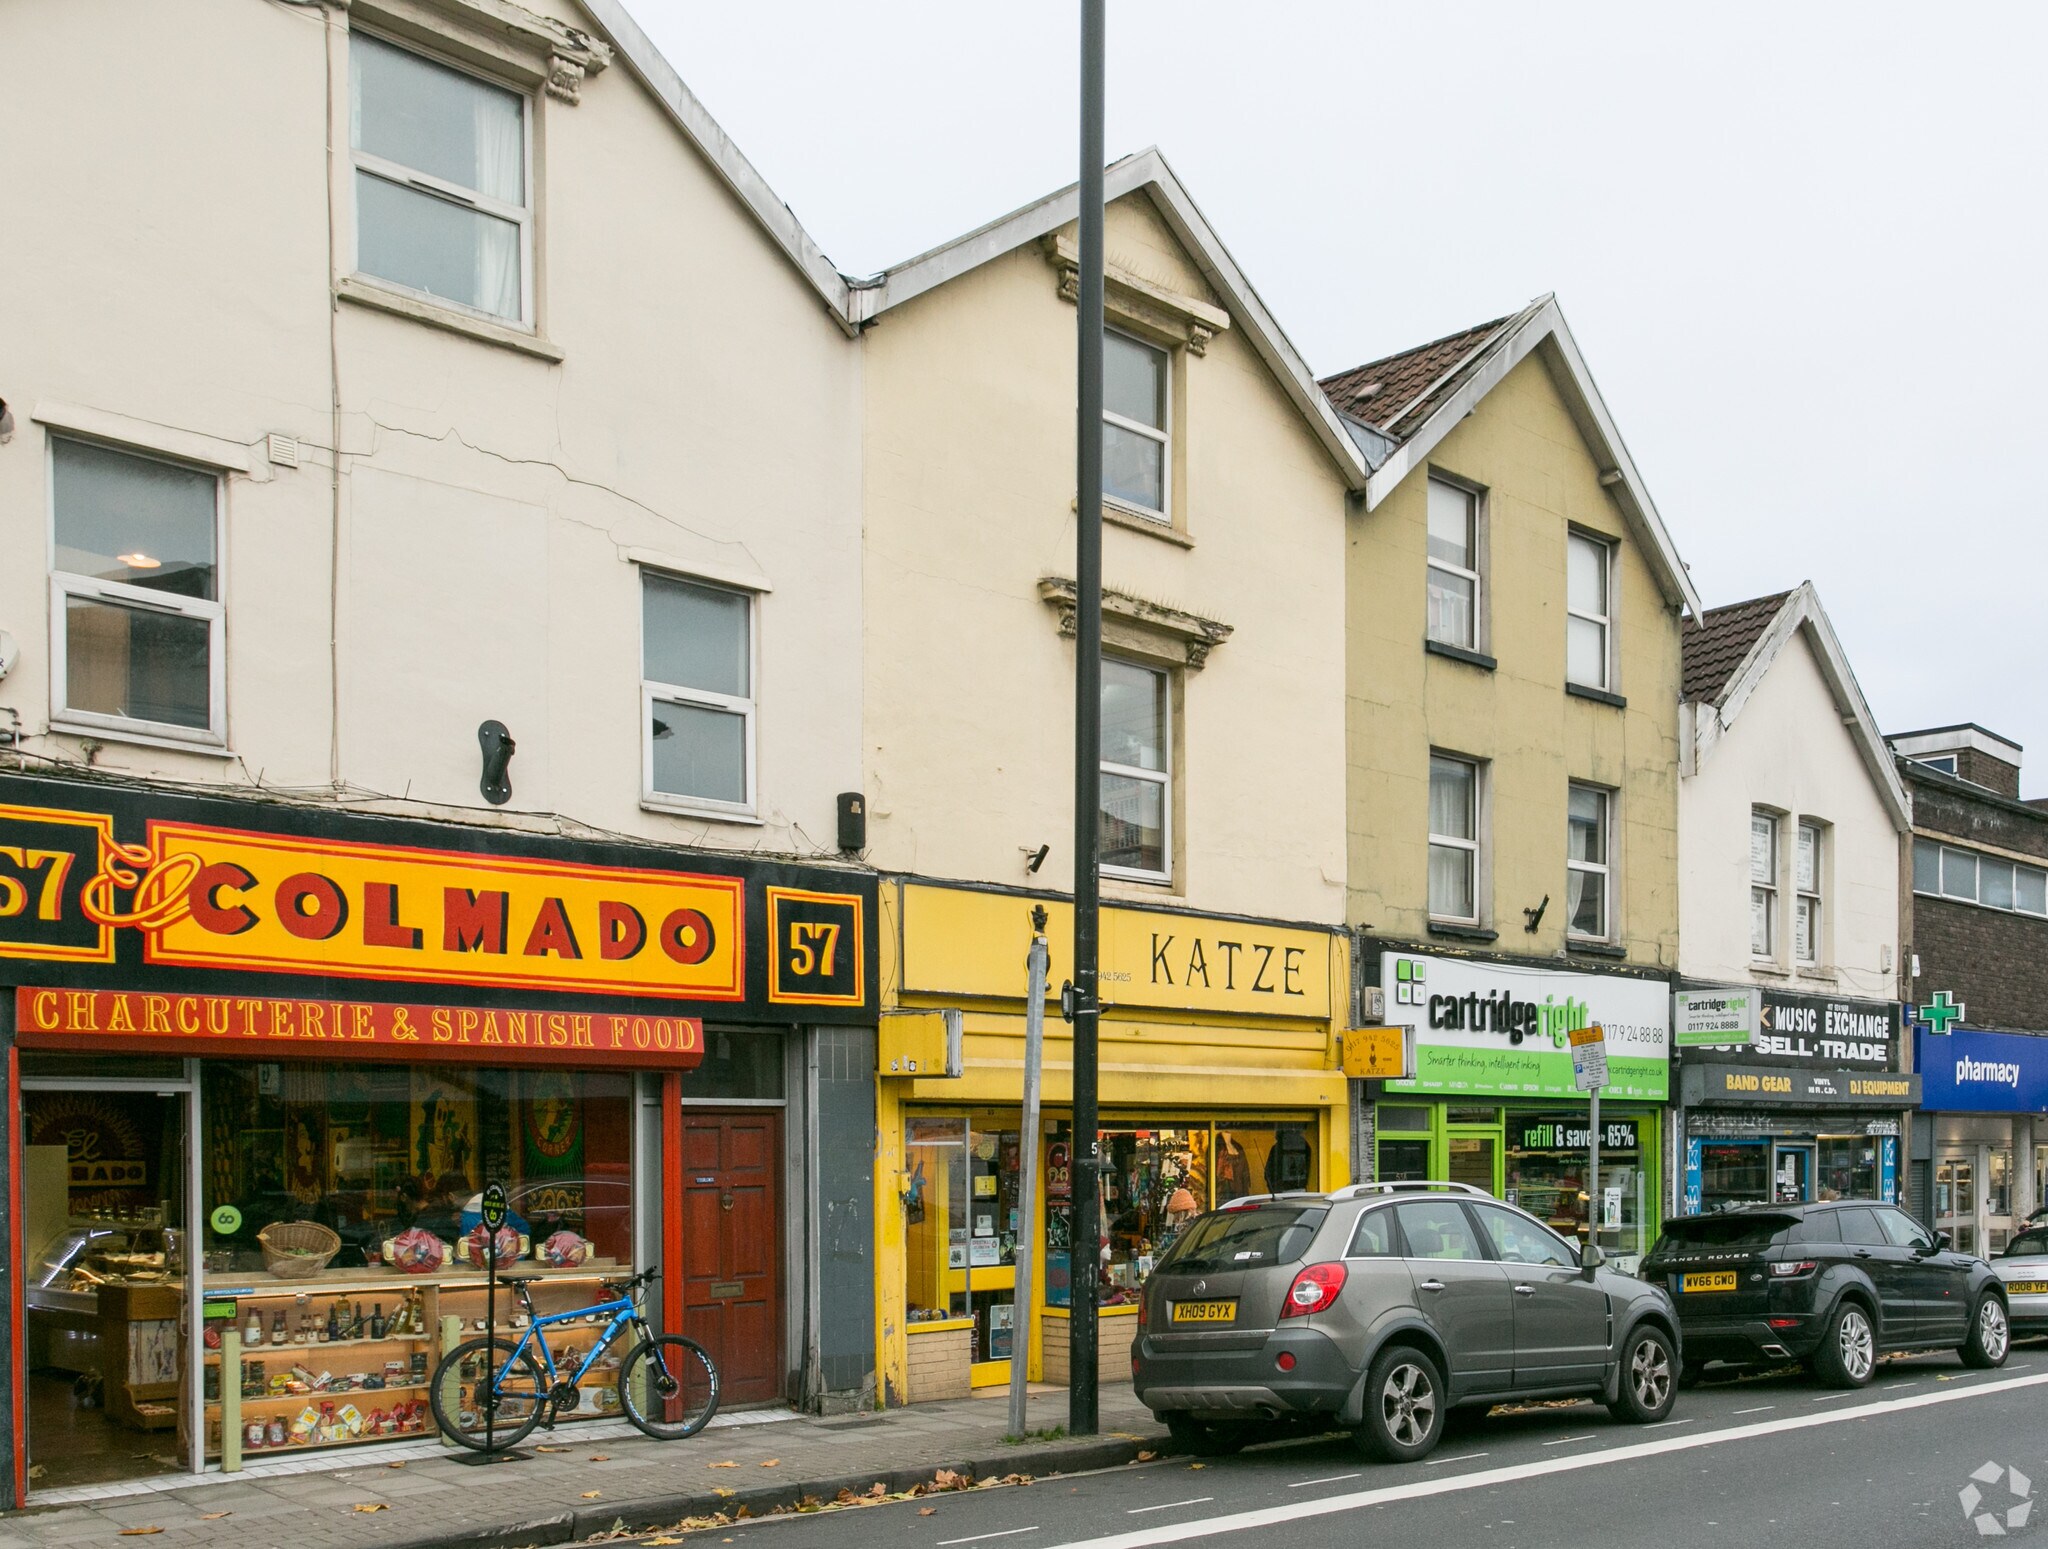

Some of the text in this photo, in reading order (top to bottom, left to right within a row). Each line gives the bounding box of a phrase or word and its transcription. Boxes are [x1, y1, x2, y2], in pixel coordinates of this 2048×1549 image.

[81, 830, 716, 965] El COLMADO
[790, 922, 840, 976] 57
[1151, 933, 1306, 996] KATZE
[1113, 972, 1131, 982] 5625
[1688, 997, 1746, 1012] cartridgeright
[33, 991, 695, 1050] CHARCUTERIE & SPANISH FOOD
[1429, 988, 1590, 1048] cartridgeright
[1688, 1021, 1739, 1031] 0117 924 8888
[1775, 1005, 1817, 1033] MUSIC
[1825, 1010, 1890, 1039] EXCHANGE
[1603, 1024, 1617, 1041] 117
[1755, 1034, 1887, 1062] SELL TRADE
[1360, 1067, 1386, 1075] KATZE
[1427, 1050, 1455, 1066] Smarter
[1488, 1054, 1520, 1075] intelligent
[1521, 1056, 1541, 1077] inking
[1608, 1064, 1663, 1077] .cartridgeright.co.uk
[1956, 1054, 2019, 1088] pharmacy
[1726, 1074, 1792, 1093] BAND GEAR
[1813, 1077, 1831, 1086] VINYL
[1850, 1080, 1909, 1096] DJ EQUIPMENT
[1524, 1124, 1553, 1147] refill
[1556, 1124, 1564, 1147] &
[1566, 1129, 1591, 1147] save
[1607, 1124, 1635, 1147] 65%
[1091, 1142, 1098, 1155] 5
[1686, 1275, 1734, 1287] WV66 GWO
[2034, 1283, 2048, 1291] YF
[1178, 1304, 1231, 1319] XH09 GYX
